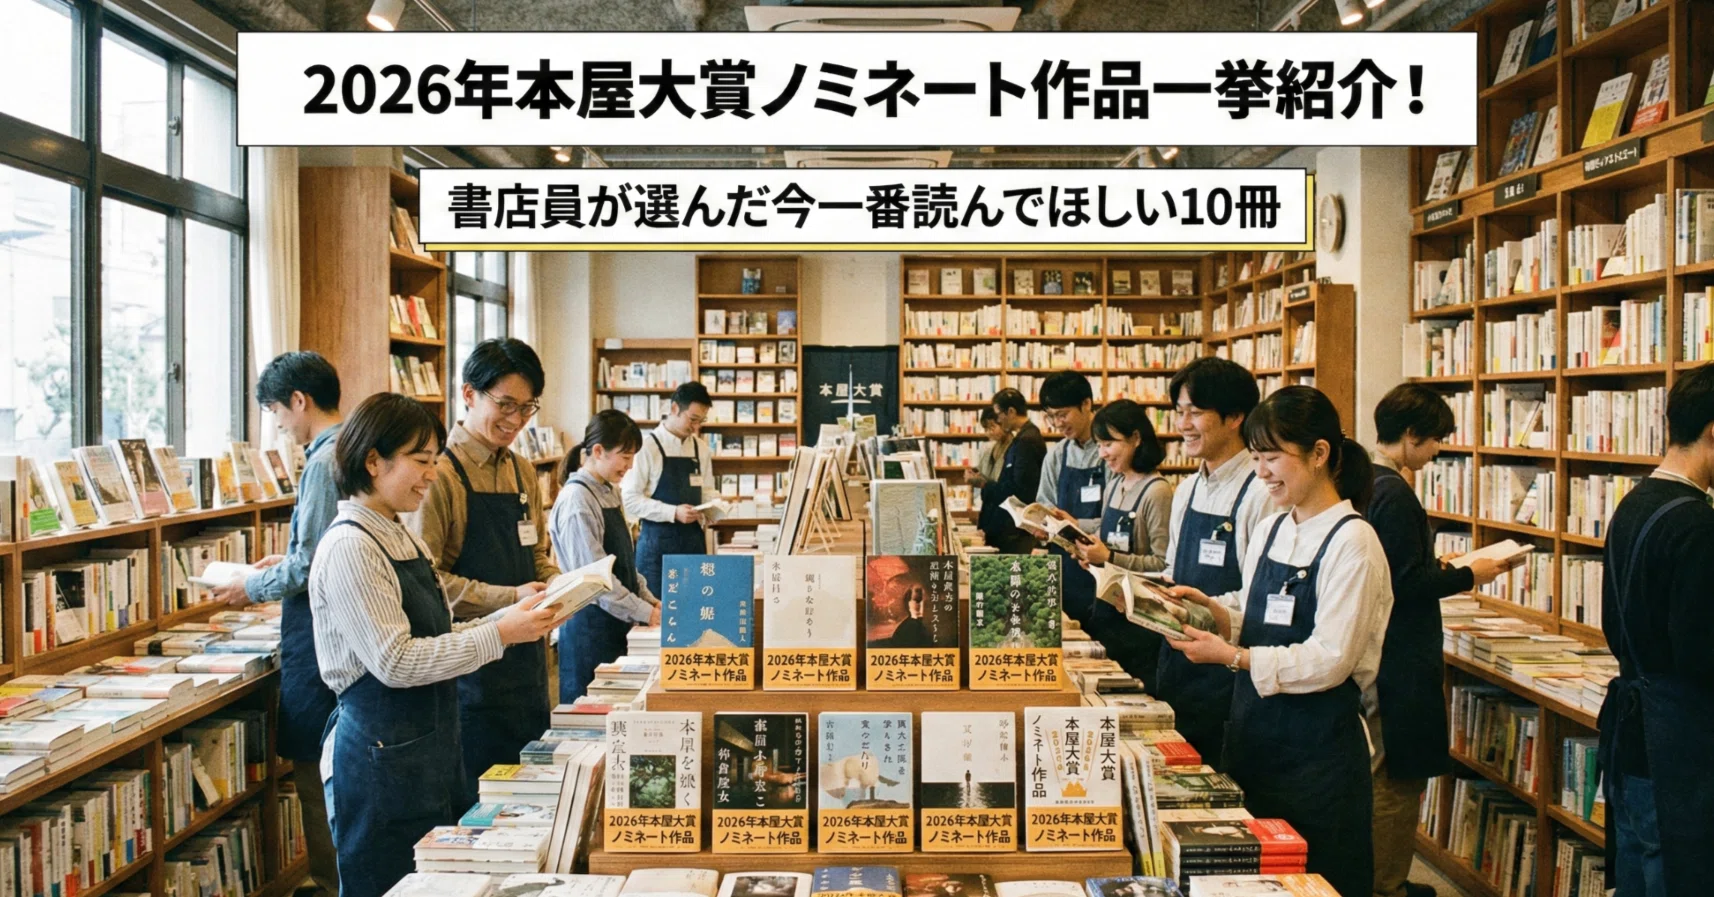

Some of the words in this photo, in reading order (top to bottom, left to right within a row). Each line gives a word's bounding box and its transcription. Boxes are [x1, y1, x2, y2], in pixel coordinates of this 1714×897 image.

[819, 383, 883, 397] 本屋大賞
[664, 652, 749, 667] 2026年本屋大賞
[767, 652, 851, 667] 2026年本屋大賞
[870, 652, 955, 667] 2026年本屋大賞
[974, 652, 1059, 667] 2026年本屋大賞
[667, 668, 747, 682] ノミネート作品
[770, 668, 850, 682] ノミネート作品
[874, 668, 954, 682] ノミネート作品
[977, 668, 1057, 682] ノミネート作品
[1065, 716, 1080, 775] 本屋大賞
[1100, 715, 1116, 781] 本屋大賞
[609, 813, 697, 828] 2026年本屋大賞
[717, 814, 804, 828] 2026年本屋大賞
[822, 814, 910, 828] 2026年本屋大賞
[925, 813, 1013, 828] 2026年本屋大賞
[1031, 811, 1118, 826] 2026年本屋大賞
[611, 830, 695, 845] ノミネート作品
[719, 830, 802, 845] ノミネート作品
[825, 830, 908, 845] ノミネート作品
[928, 829, 1011, 844] ノミネート作品
[1034, 828, 1116, 843] ノミネート作品
